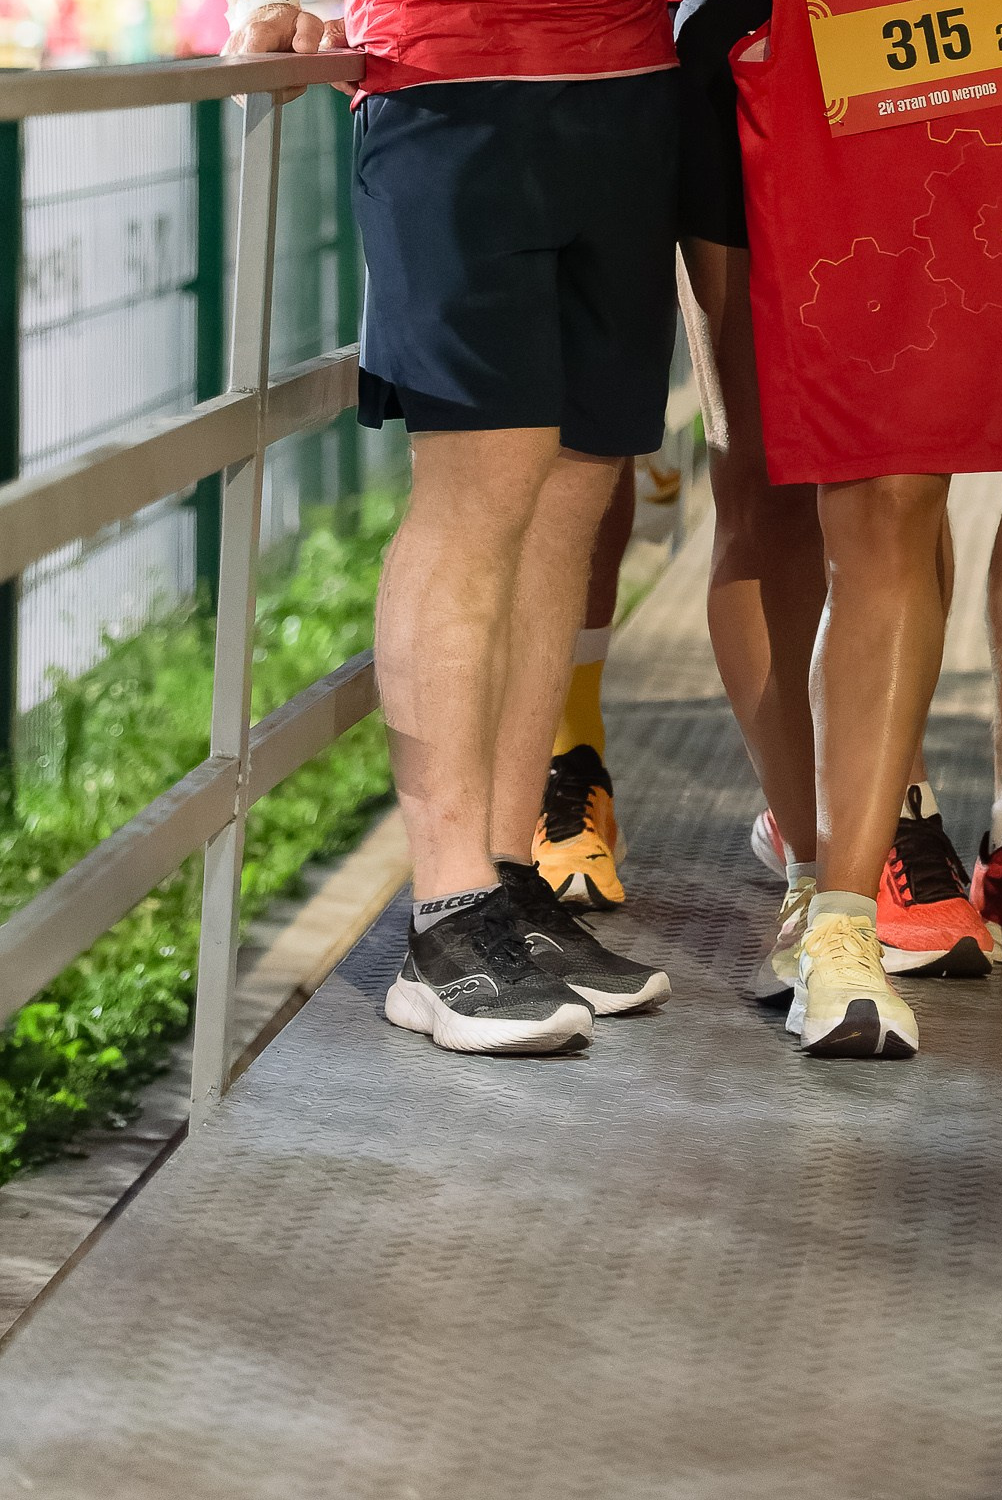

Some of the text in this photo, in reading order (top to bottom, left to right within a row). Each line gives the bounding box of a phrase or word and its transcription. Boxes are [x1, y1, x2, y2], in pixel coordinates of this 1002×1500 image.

[882, 8, 972, 71] 315
[878, 82, 997, 116] 2й этап 100 метров
